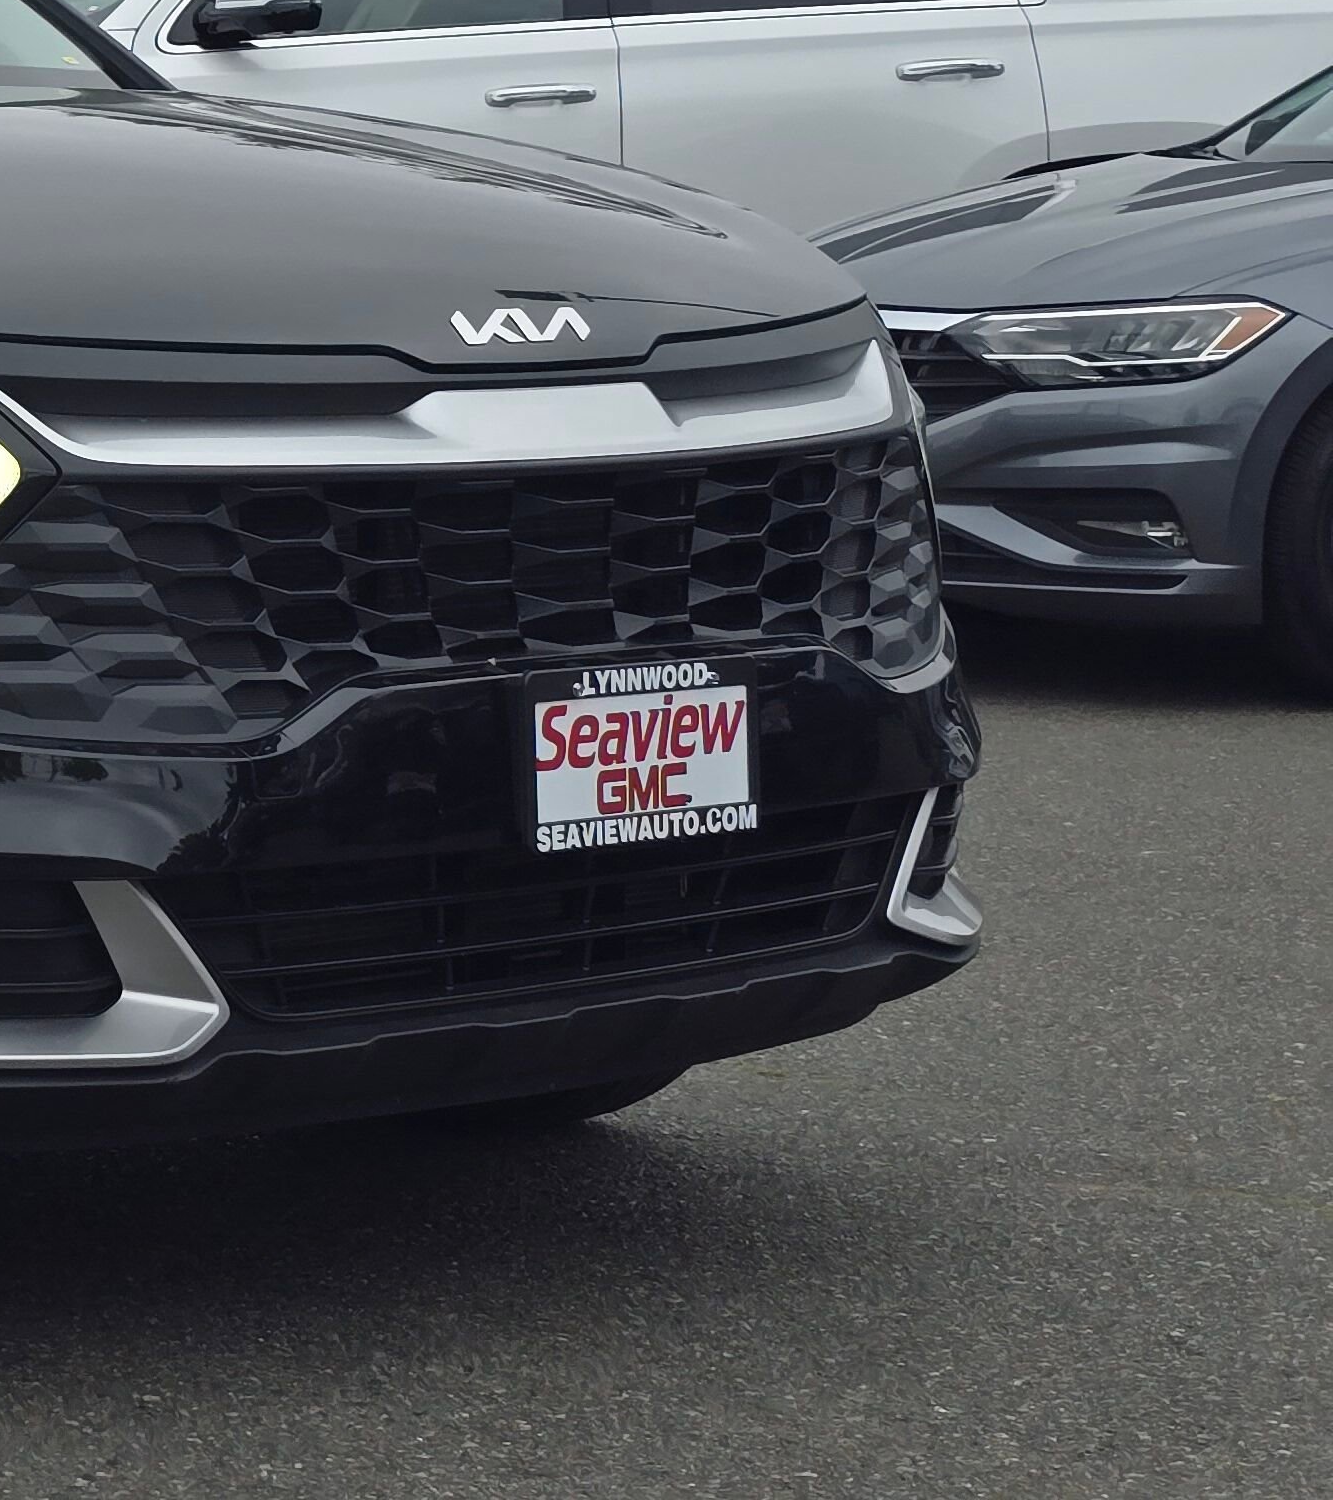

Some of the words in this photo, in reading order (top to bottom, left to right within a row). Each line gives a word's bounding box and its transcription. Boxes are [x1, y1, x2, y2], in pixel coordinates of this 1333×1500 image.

[450, 306, 591, 345] KIA
[582, 663, 709, 696] LYNNWOOD
[535, 694, 746, 772] Seaview
[596, 761, 688, 816] GMC
[536, 803, 758, 853] SEAVIEWAUTO.COM
